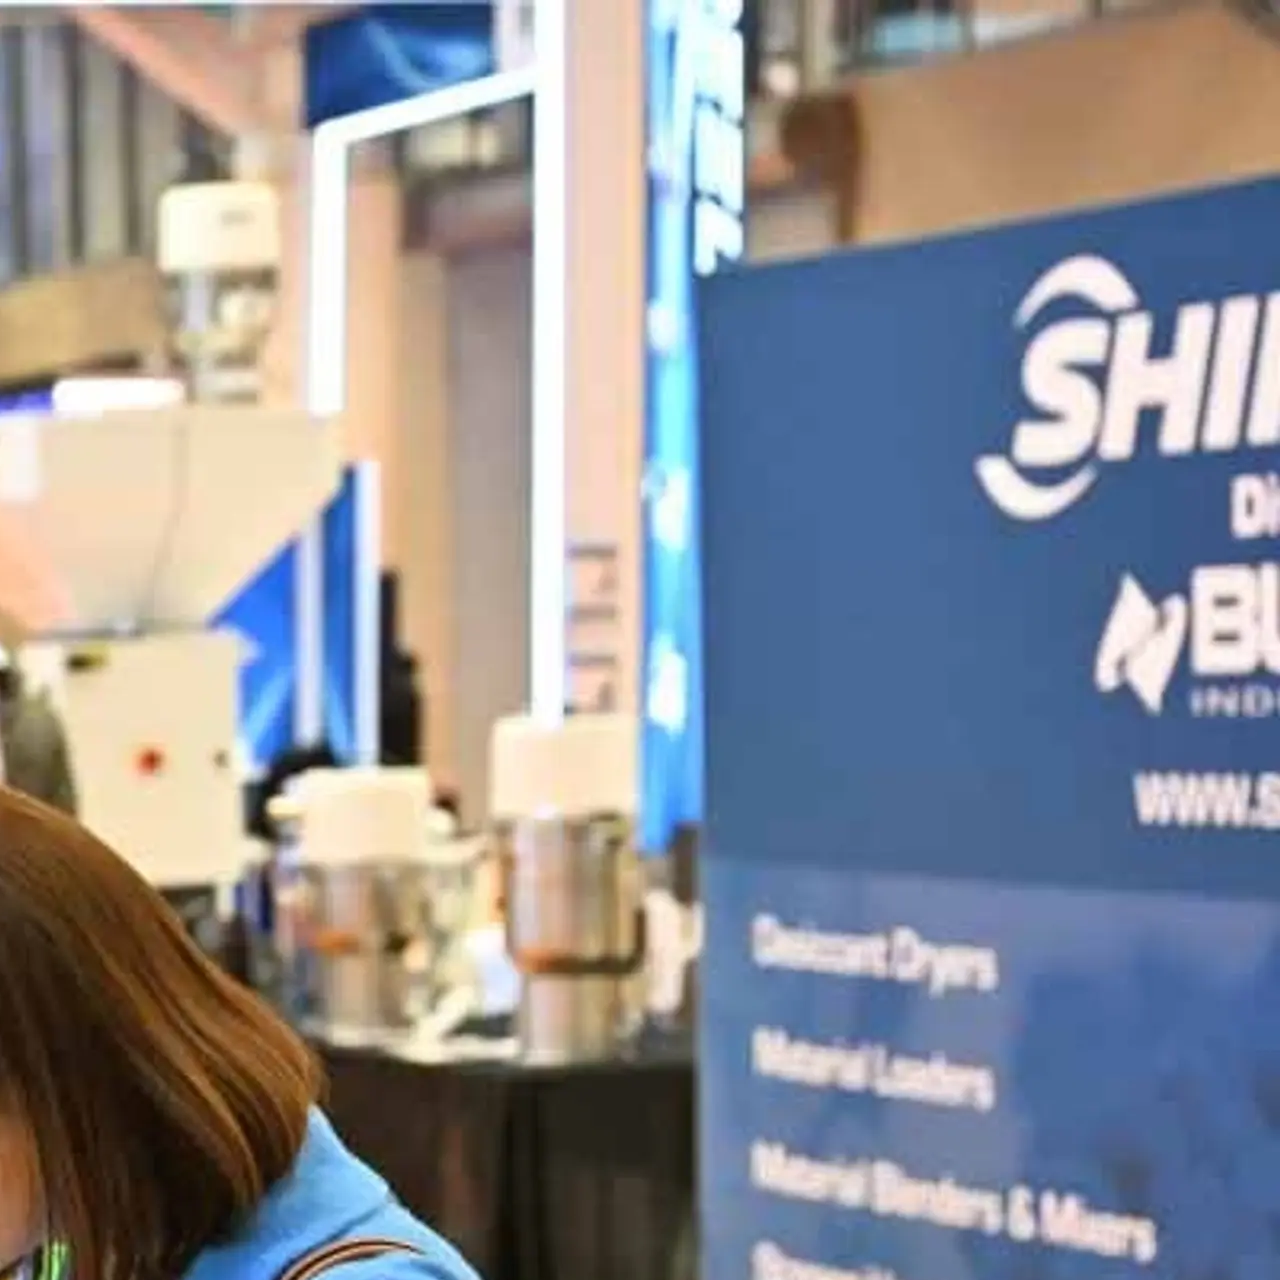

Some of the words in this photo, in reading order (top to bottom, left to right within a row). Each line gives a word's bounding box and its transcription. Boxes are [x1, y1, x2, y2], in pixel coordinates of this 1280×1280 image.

[1191, 684, 1280, 718] IND
[889, 926, 999, 996] Dryers
[1007, 1184, 1036, 1241] &
